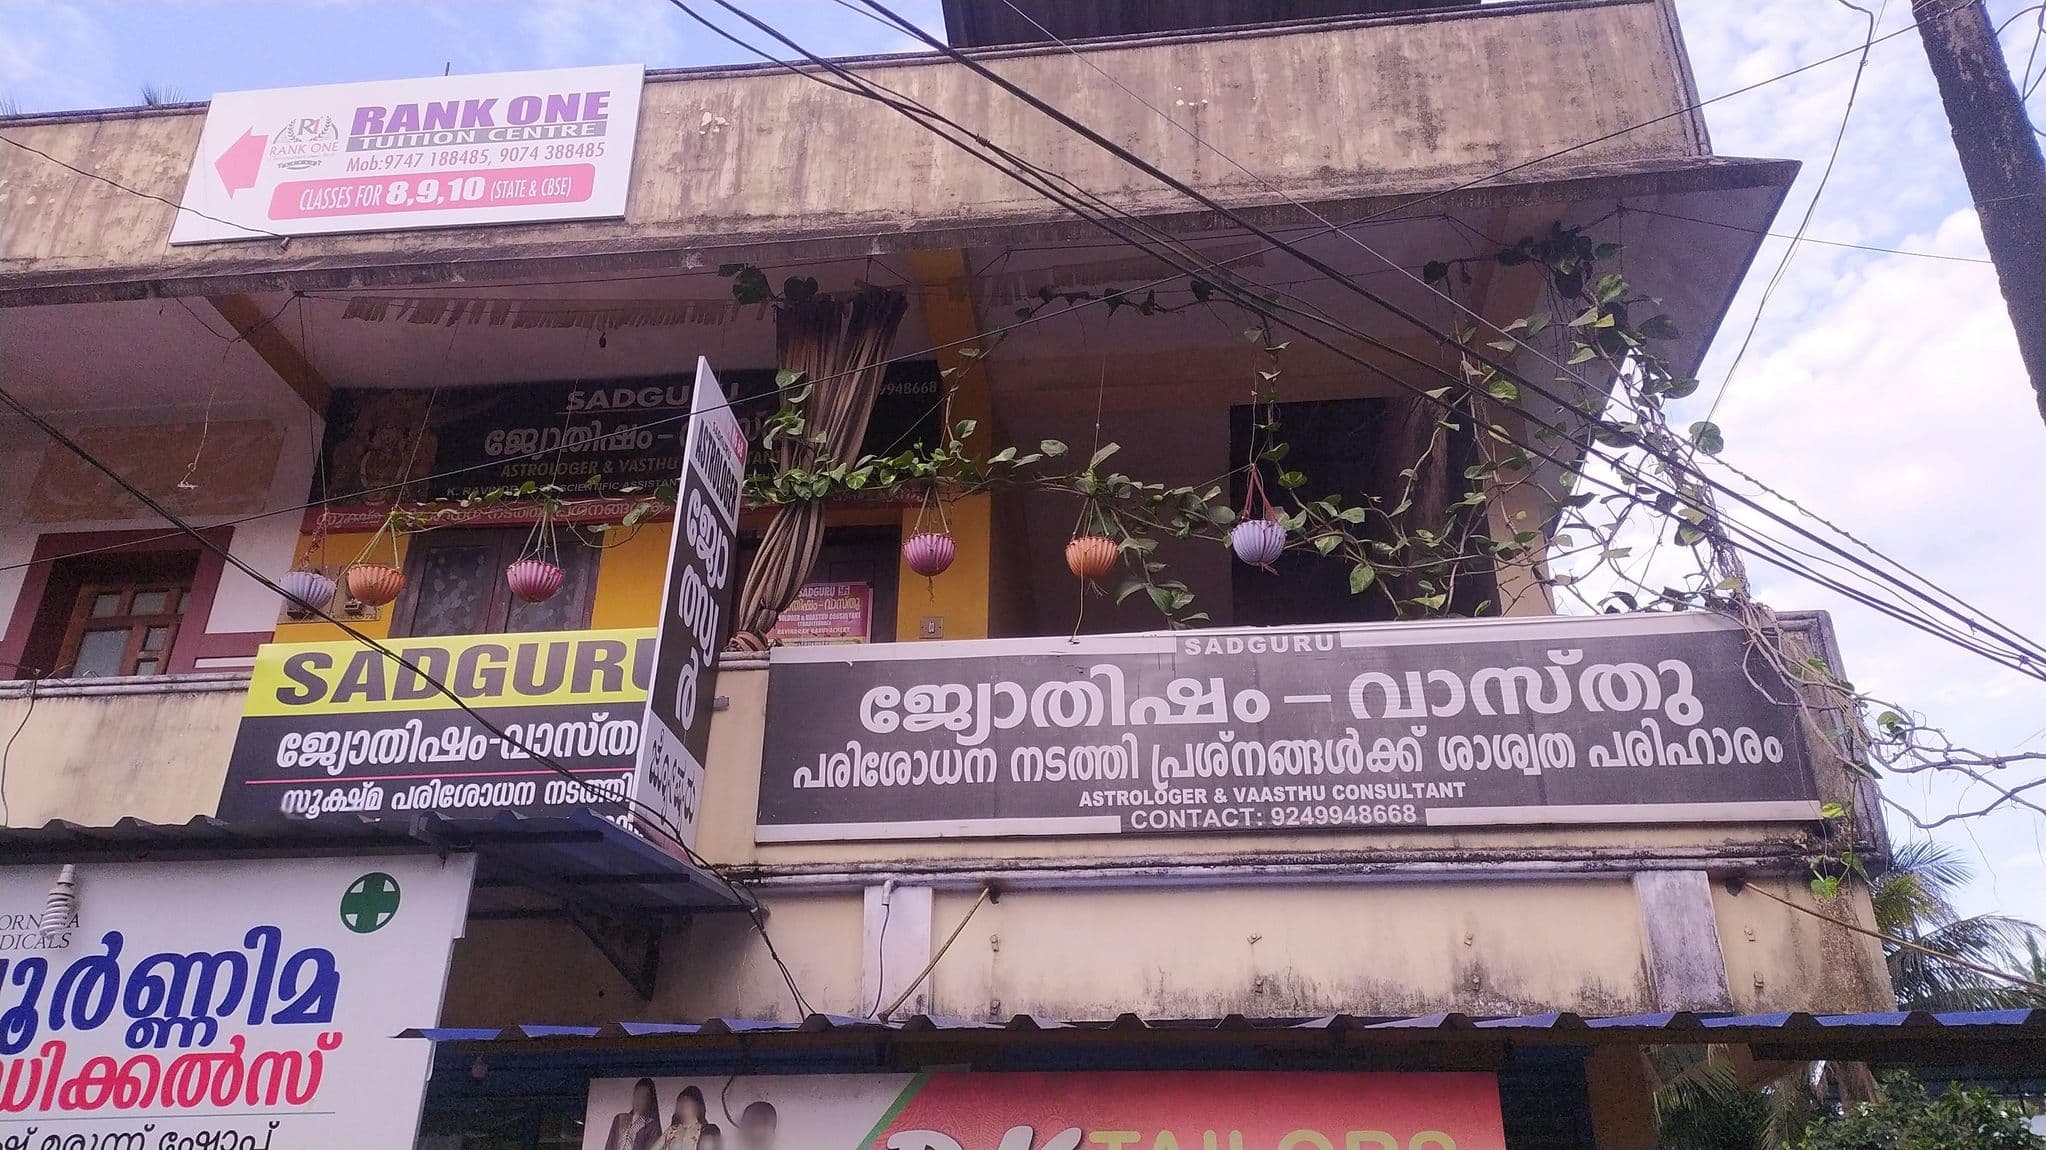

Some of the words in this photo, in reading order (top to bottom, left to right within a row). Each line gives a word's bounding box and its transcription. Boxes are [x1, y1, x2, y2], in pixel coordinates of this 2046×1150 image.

[349, 97, 499, 136] RANK
[506, 90, 611, 126] ONE
[269, 144, 306, 157] RANK
[310, 141, 340, 154] ONE
[359, 130, 476, 150] TUITION
[487, 122, 597, 142] CENTRE
[345, 152, 424, 173] Mob:9747
[430, 148, 492, 168] 188485,
[500, 145, 539, 163] 9074
[544, 141, 606, 161] 388485
[299, 185, 353, 212] CLASSES
[354, 183, 383, 207] FOR
[489, 177, 528, 202] (STATE
[528, 182, 538, 199] &
[540, 176, 574, 198] CBSE)
[694, 417, 739, 522] ASTROLOGER
[1185, 633, 1335, 657] SADGURU
[859, 663, 1271, 747] ജ്യോതിഷം
[1347, 648, 1705, 727] വാസ്തു
[792, 740, 998, 789] പരിശോധന
[1010, 733, 1139, 783] നടത്തി
[1437, 731, 1577, 776] ശാശ്വത
[1588, 717, 1785, 769] പരിഹാരം
[280, 781, 384, 820] സൂക്ഷ്മ
[390, 778, 535, 812] പരിശോധന
[1079, 787, 1207, 808] ASTROLOGER
[1213, 787, 1227, 805] &
[1233, 784, 1326, 804] VAASTHU
[1332, 781, 1467, 801] CONSULTANT
[1130, 807, 1264, 830] CONTACT:
[1270, 804, 1418, 828] 9249948668
